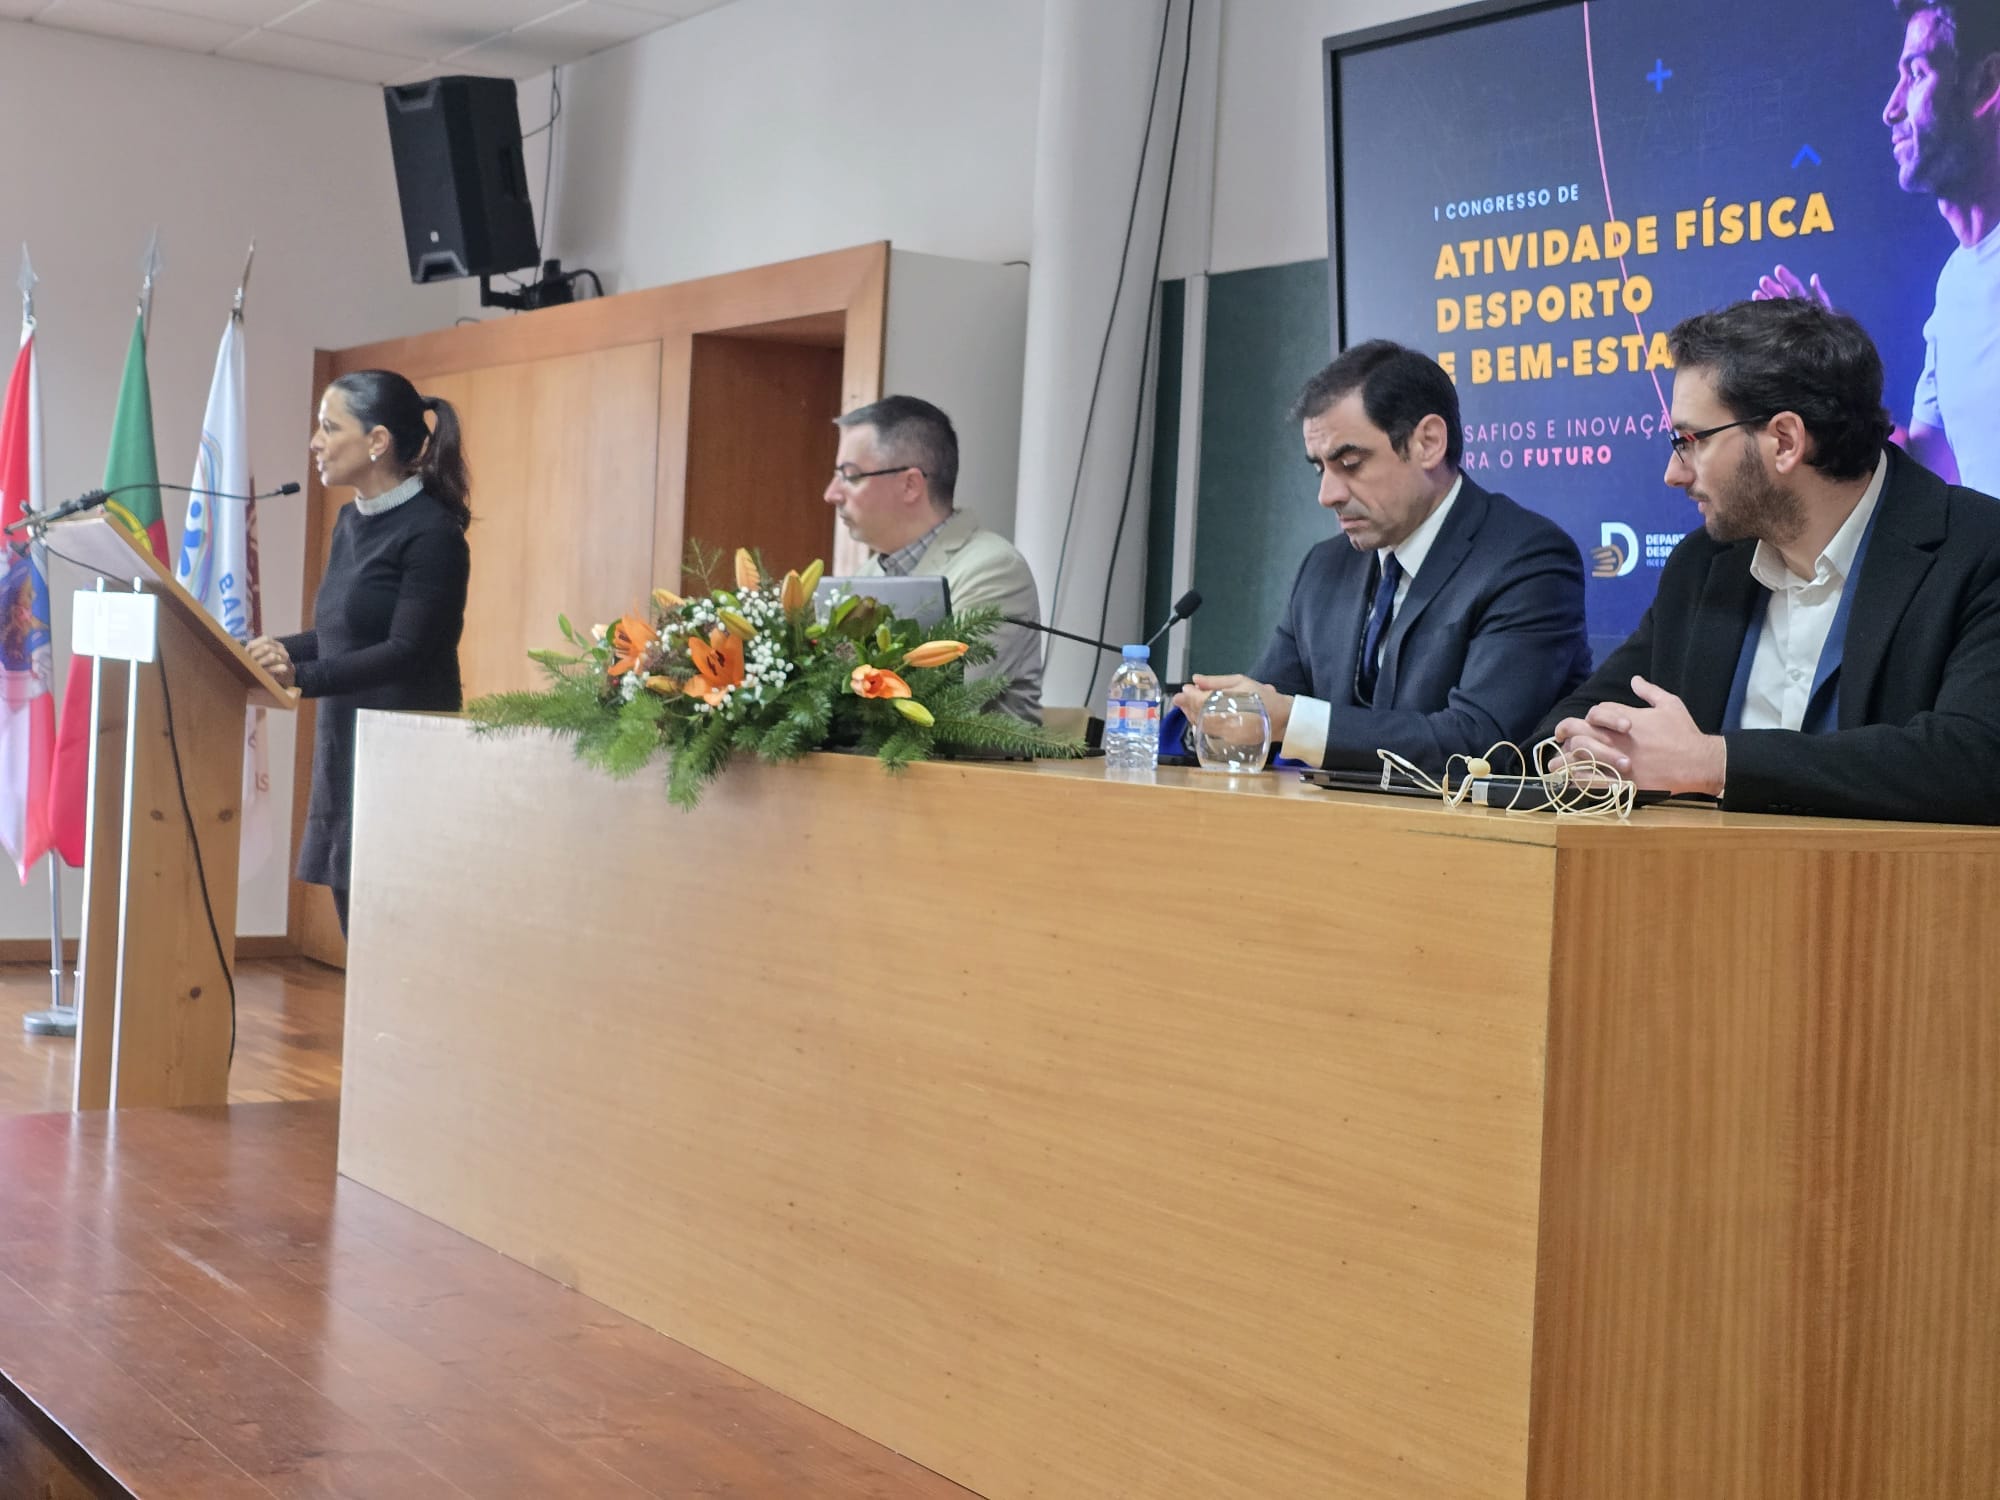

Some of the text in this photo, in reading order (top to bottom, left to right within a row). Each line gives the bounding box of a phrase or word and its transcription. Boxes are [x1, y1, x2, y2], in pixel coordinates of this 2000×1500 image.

[1433, 184, 1580, 222] I CONGRESSO DE
[1434, 192, 1835, 280] ATIVIDADE FÍSICA
[1437, 275, 1653, 333] DESPORTO
[1471, 332, 1676, 385] BEM-ESTA
[1464, 410, 1672, 444] SAFIOS E INOVAÇÃ
[1465, 444, 1612, 470] RA O FUTURO
[219, 573, 247, 638] BAN
